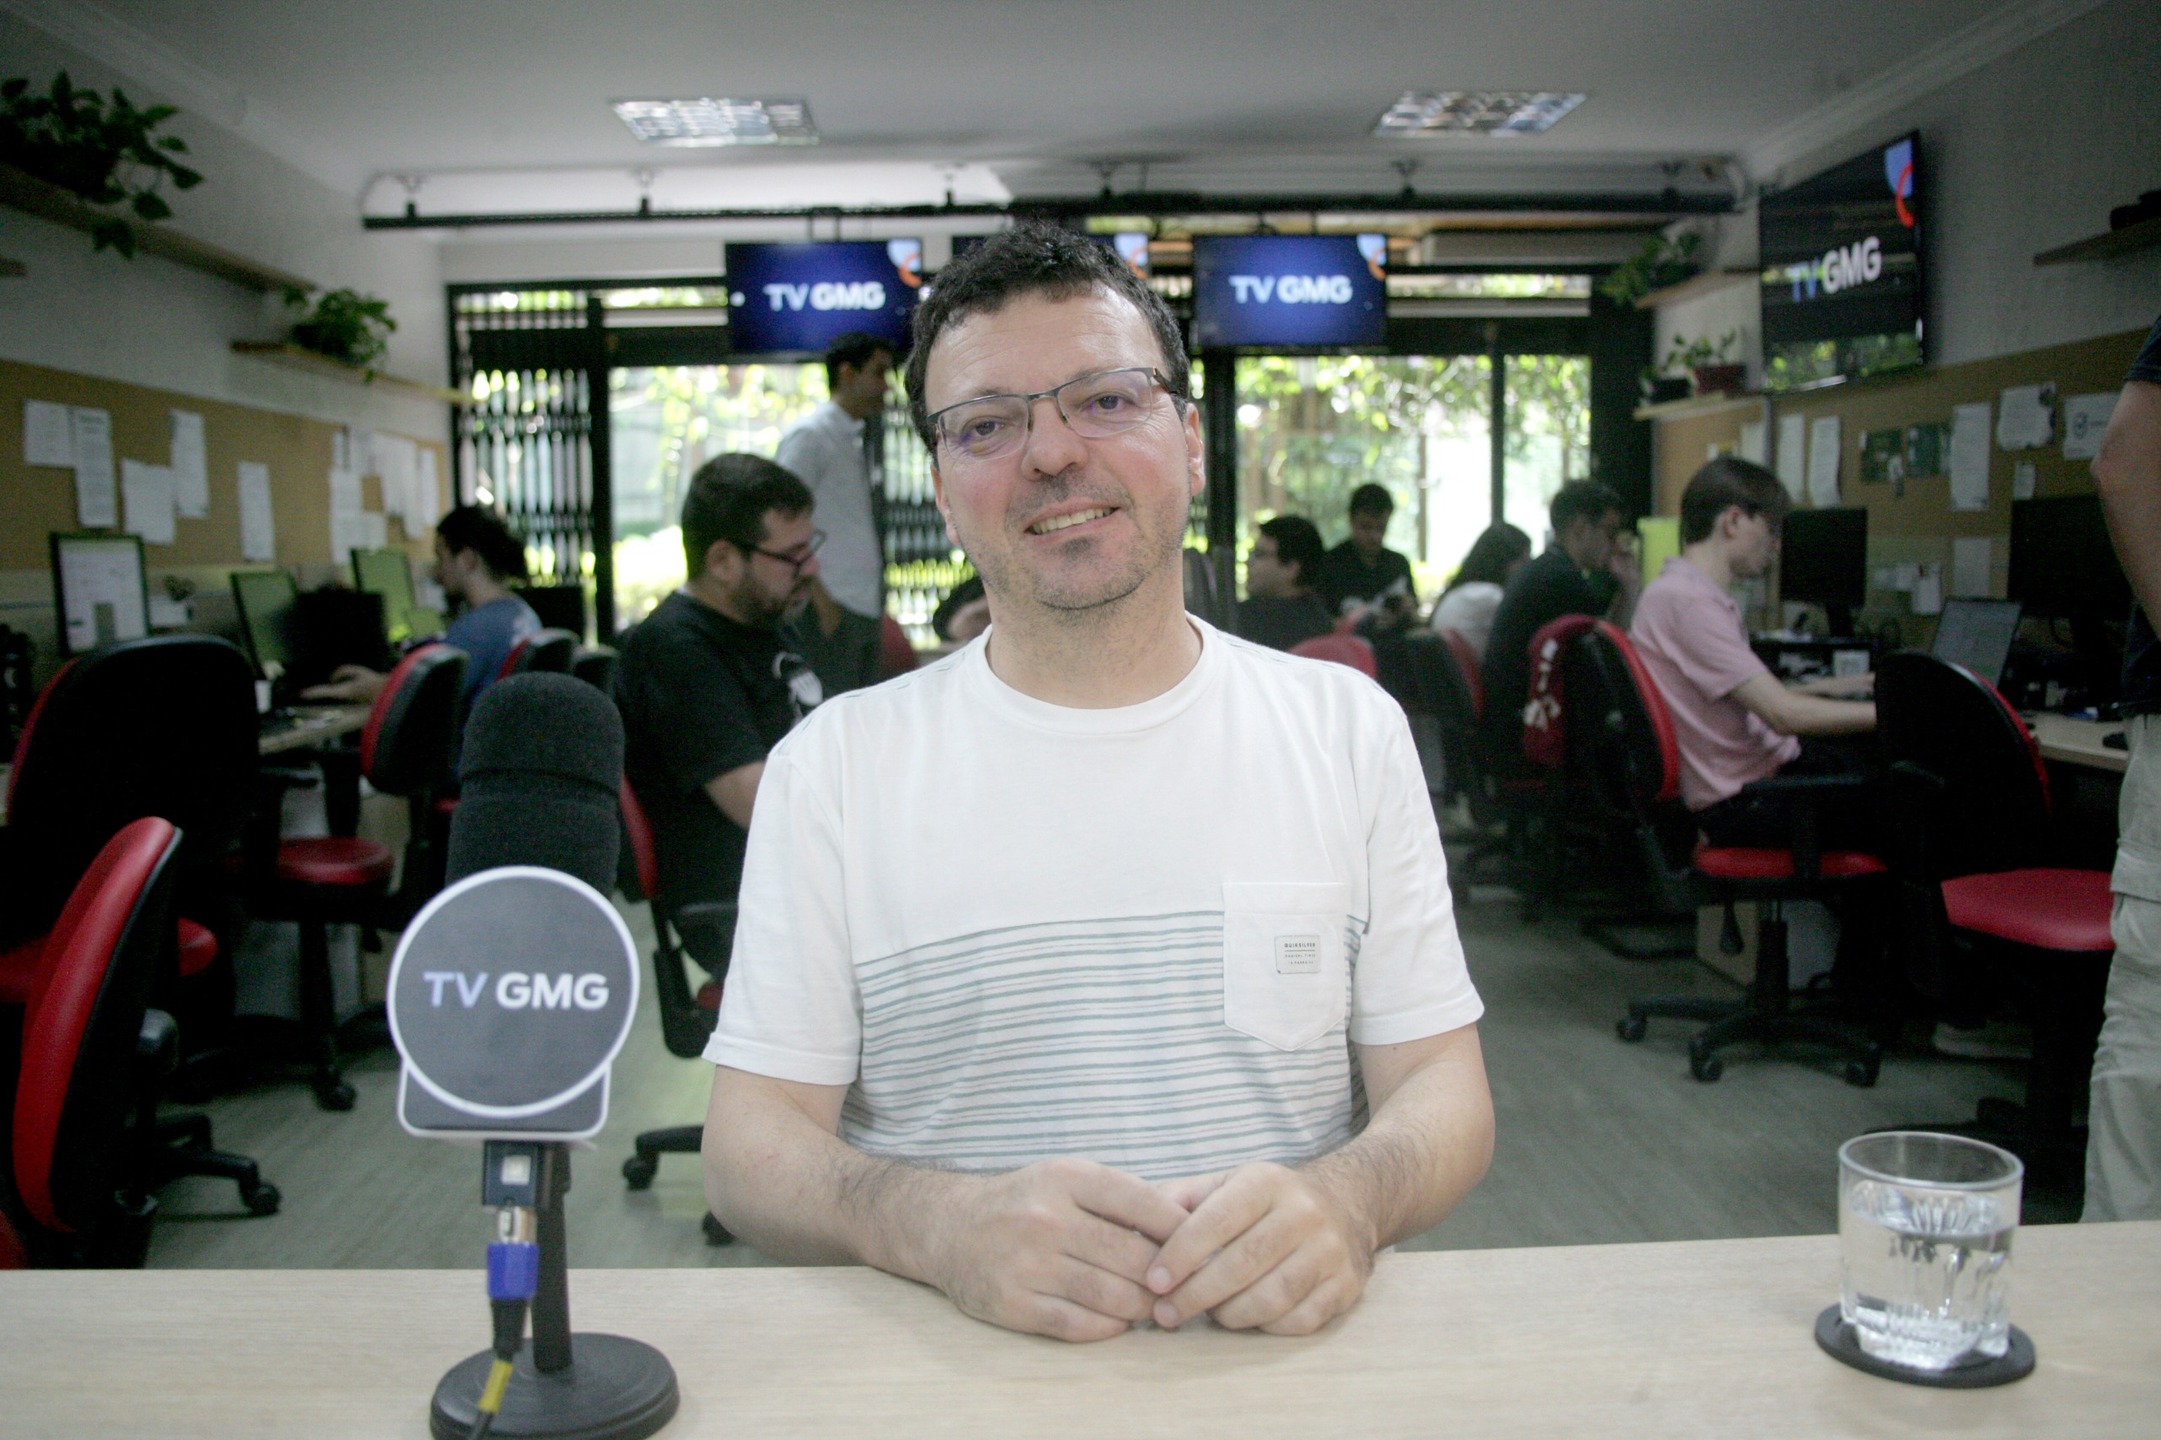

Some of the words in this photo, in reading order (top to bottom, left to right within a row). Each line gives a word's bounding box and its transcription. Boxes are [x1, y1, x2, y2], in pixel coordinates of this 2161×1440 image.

[1822, 236, 1882, 294] GMG
[764, 283, 809, 311] TV
[809, 281, 886, 311] GMG
[1228, 275, 1276, 304] TV
[1276, 275, 1353, 304] GMG
[423, 971, 489, 1009] TV
[495, 971, 611, 1011] GMG
